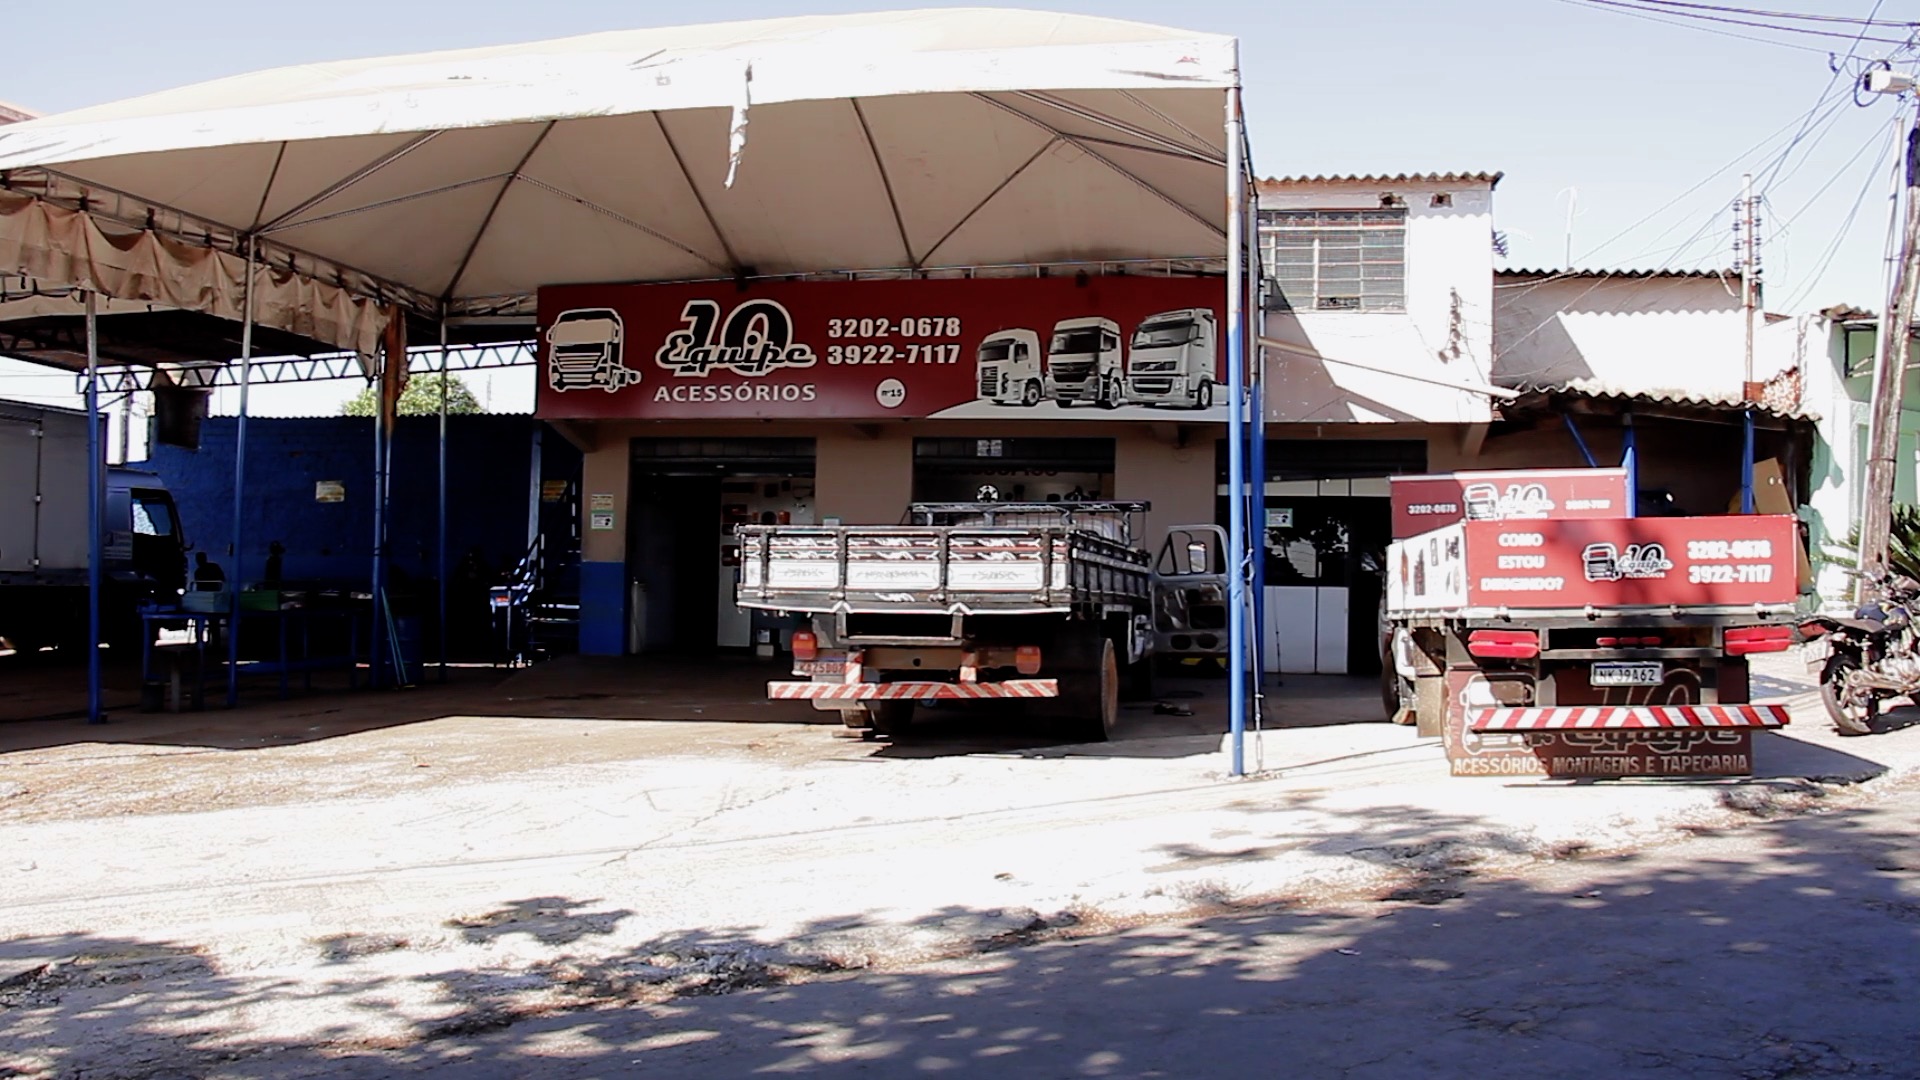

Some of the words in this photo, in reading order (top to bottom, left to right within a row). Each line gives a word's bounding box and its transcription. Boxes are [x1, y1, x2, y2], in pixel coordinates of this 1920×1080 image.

[828, 317, 960, 338] 3202-0678
[655, 330, 817, 377] Equipe
[827, 344, 960, 364] 3922-7117
[653, 382, 816, 402] ACESSÓRIOS
[1499, 533, 1544, 547] COMO
[1499, 555, 1545, 569] ESTOU
[1688, 564, 1772, 584] 3922-7117
[1453, 753, 1548, 774] ACESSÓRIOS
[1553, 756, 1640, 773] MONTAGENS
[1645, 756, 1656, 773] E
